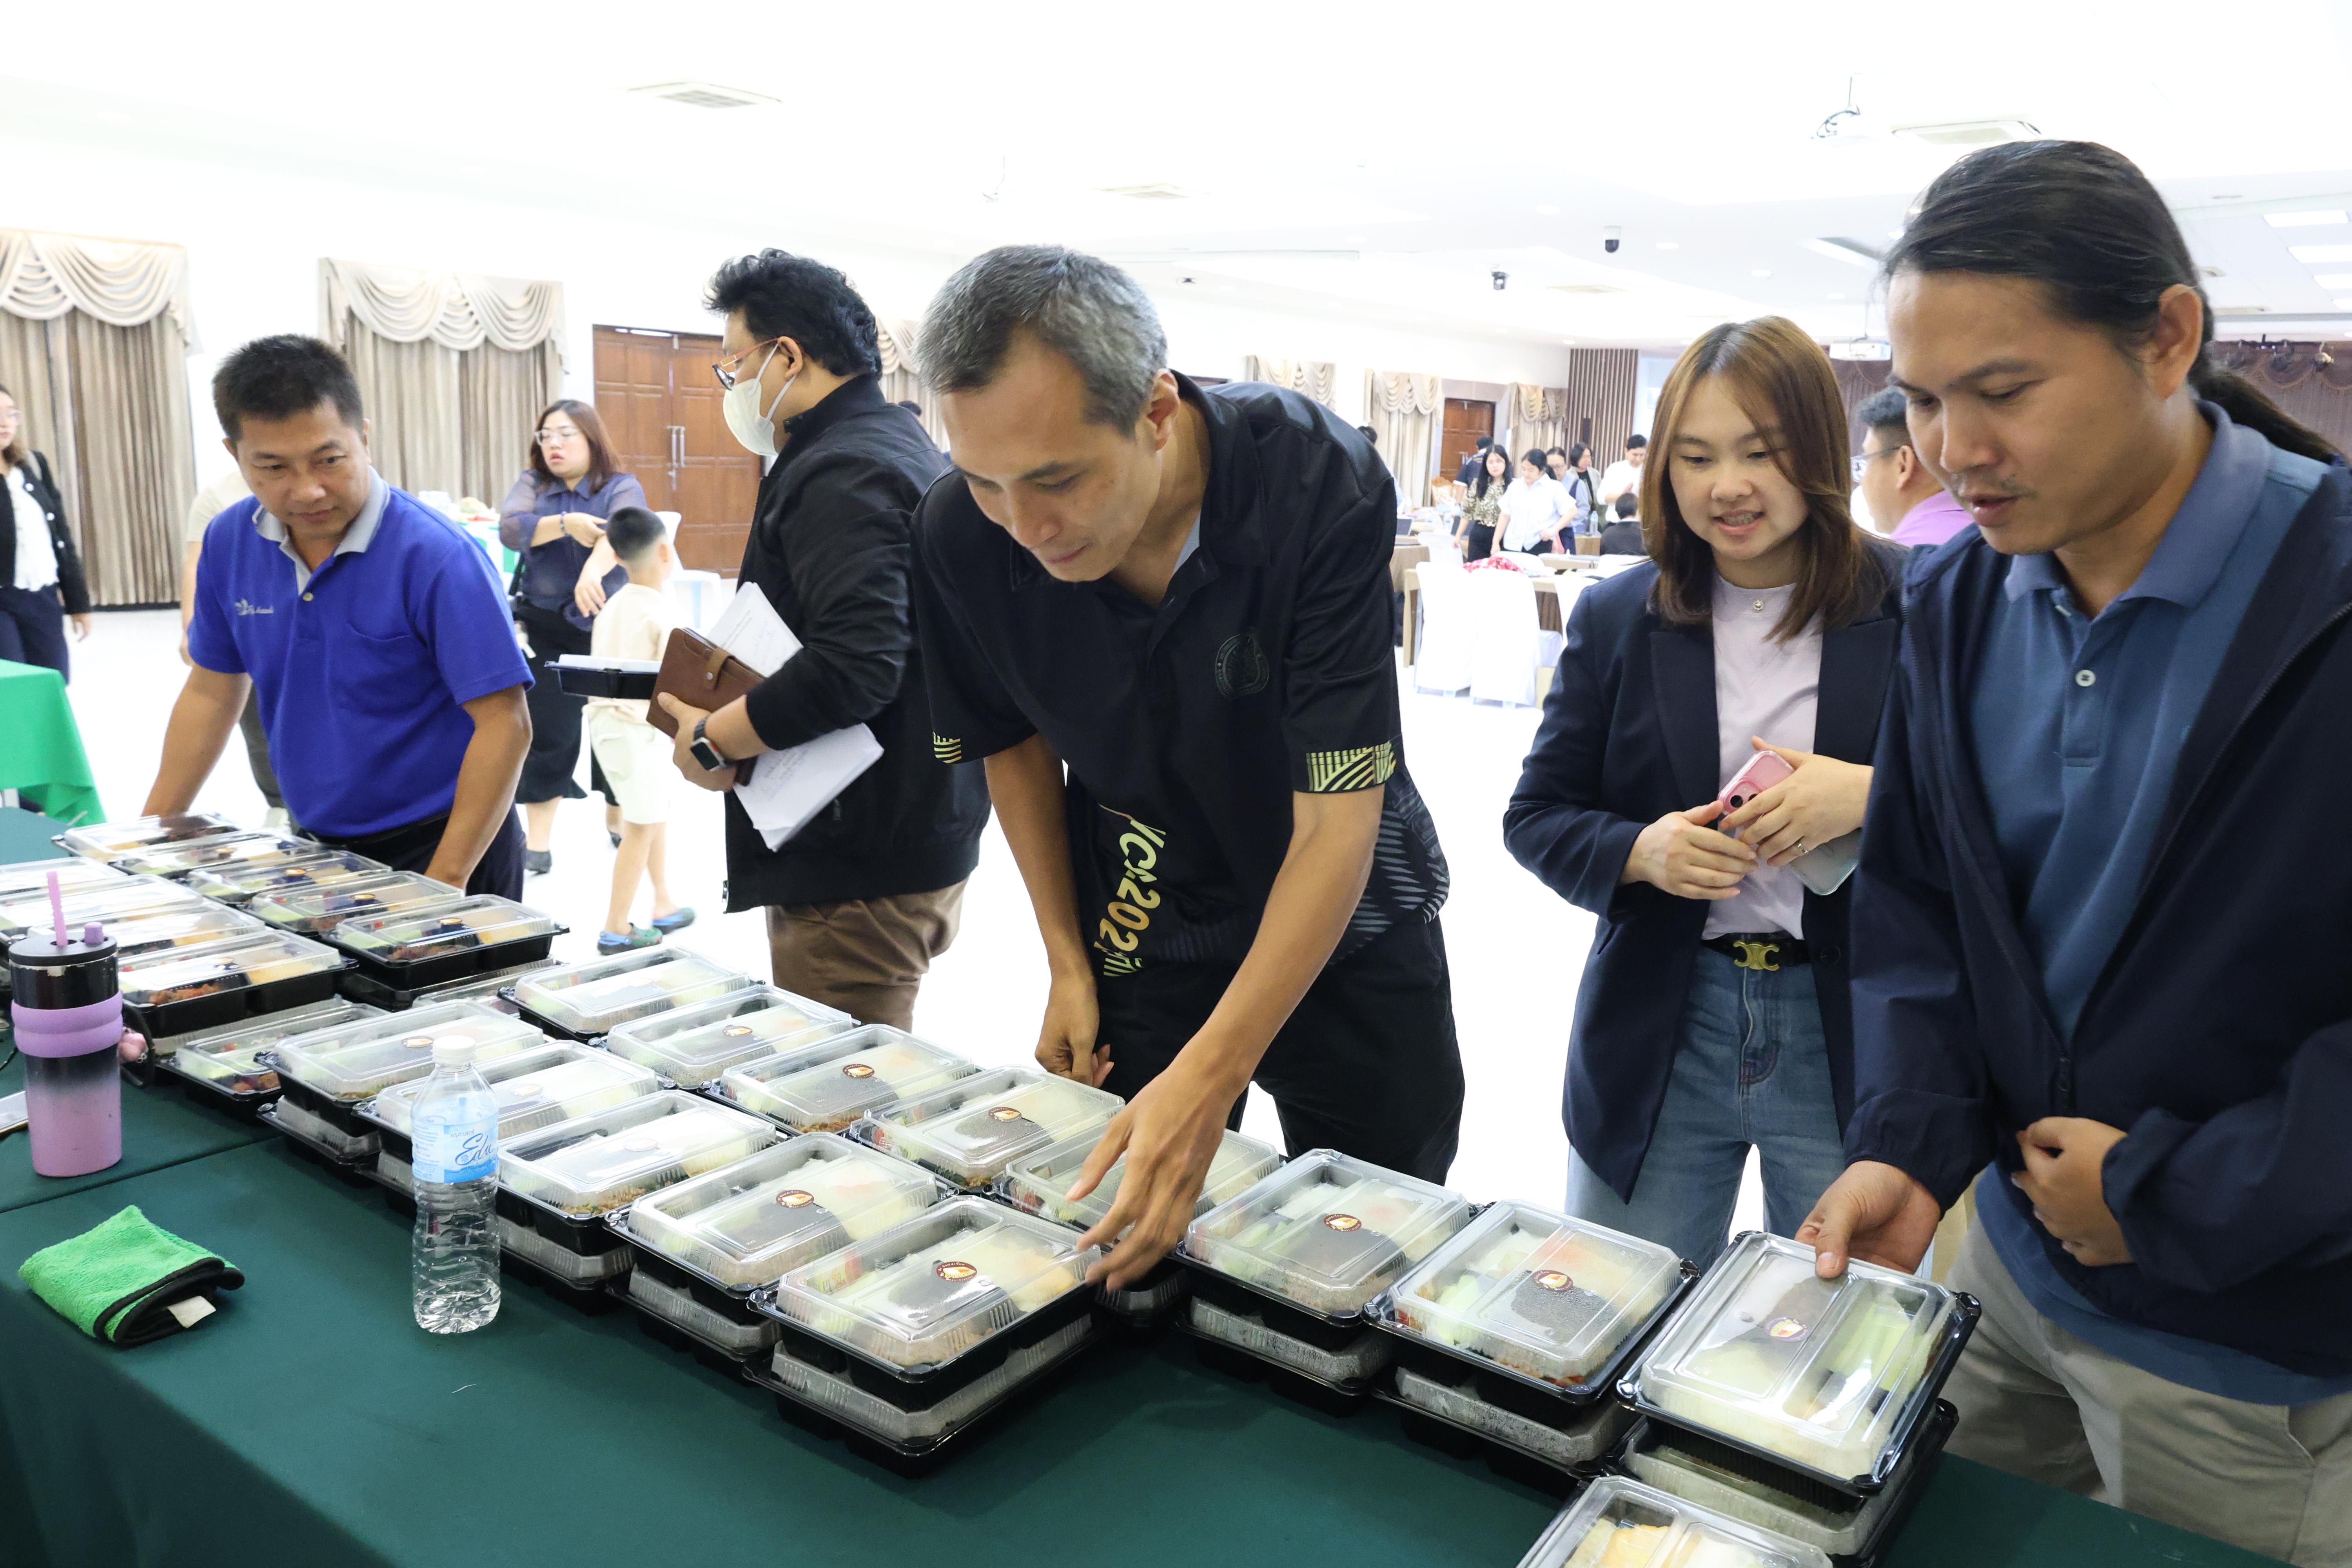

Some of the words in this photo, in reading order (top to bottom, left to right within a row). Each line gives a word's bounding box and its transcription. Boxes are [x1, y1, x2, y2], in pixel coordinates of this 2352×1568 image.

[450, 1129, 475, 1138] ครุศาสตร์
[455, 1133, 492, 1166] Edu
